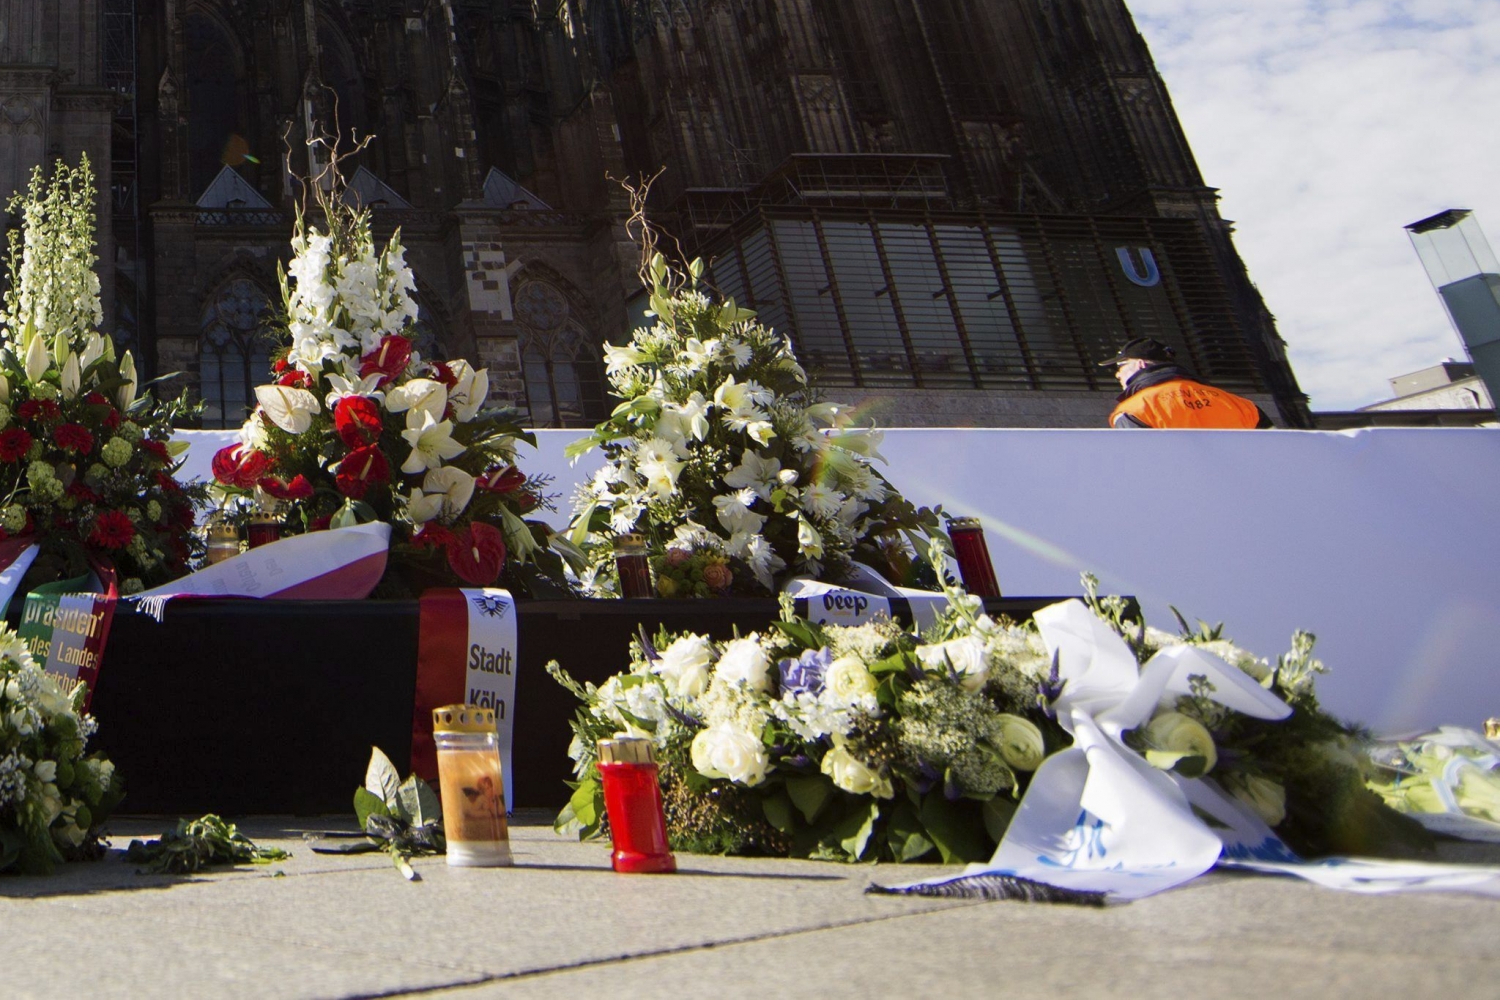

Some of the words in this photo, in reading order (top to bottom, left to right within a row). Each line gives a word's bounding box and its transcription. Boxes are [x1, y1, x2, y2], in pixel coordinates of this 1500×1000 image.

[1115, 247, 1160, 287] U
[29, 635, 52, 658] des
[57, 641, 100, 671] Landes
[469, 643, 512, 675] Stadt
[470, 688, 505, 720] Köln
